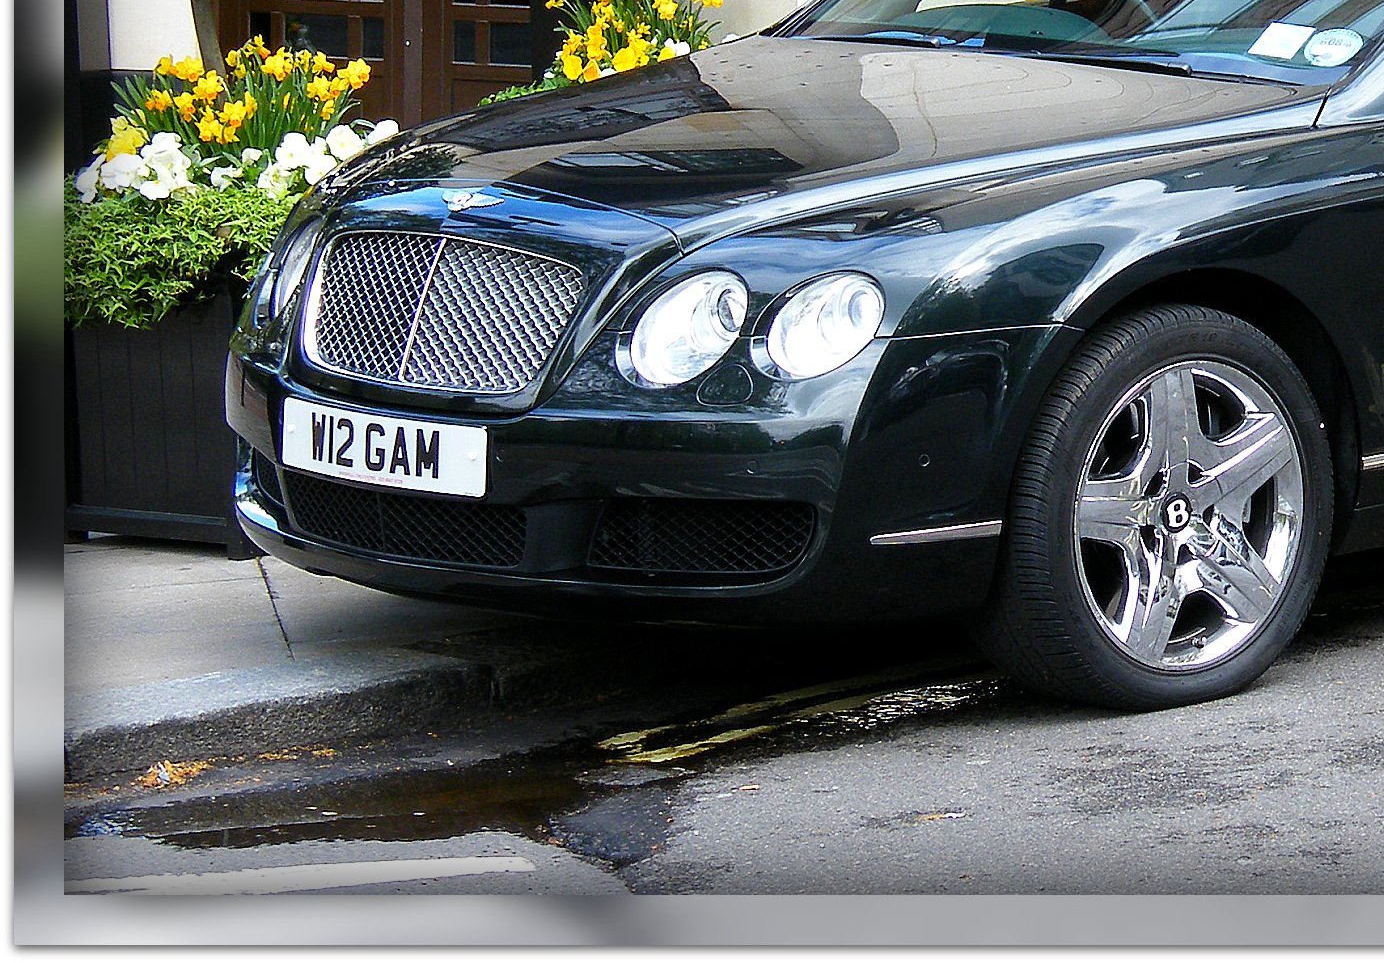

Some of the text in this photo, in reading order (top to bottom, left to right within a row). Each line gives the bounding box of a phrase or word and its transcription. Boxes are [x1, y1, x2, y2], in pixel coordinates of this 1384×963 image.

[311, 412, 440, 479] W12 GAM
[1166, 498, 1190, 528] B
